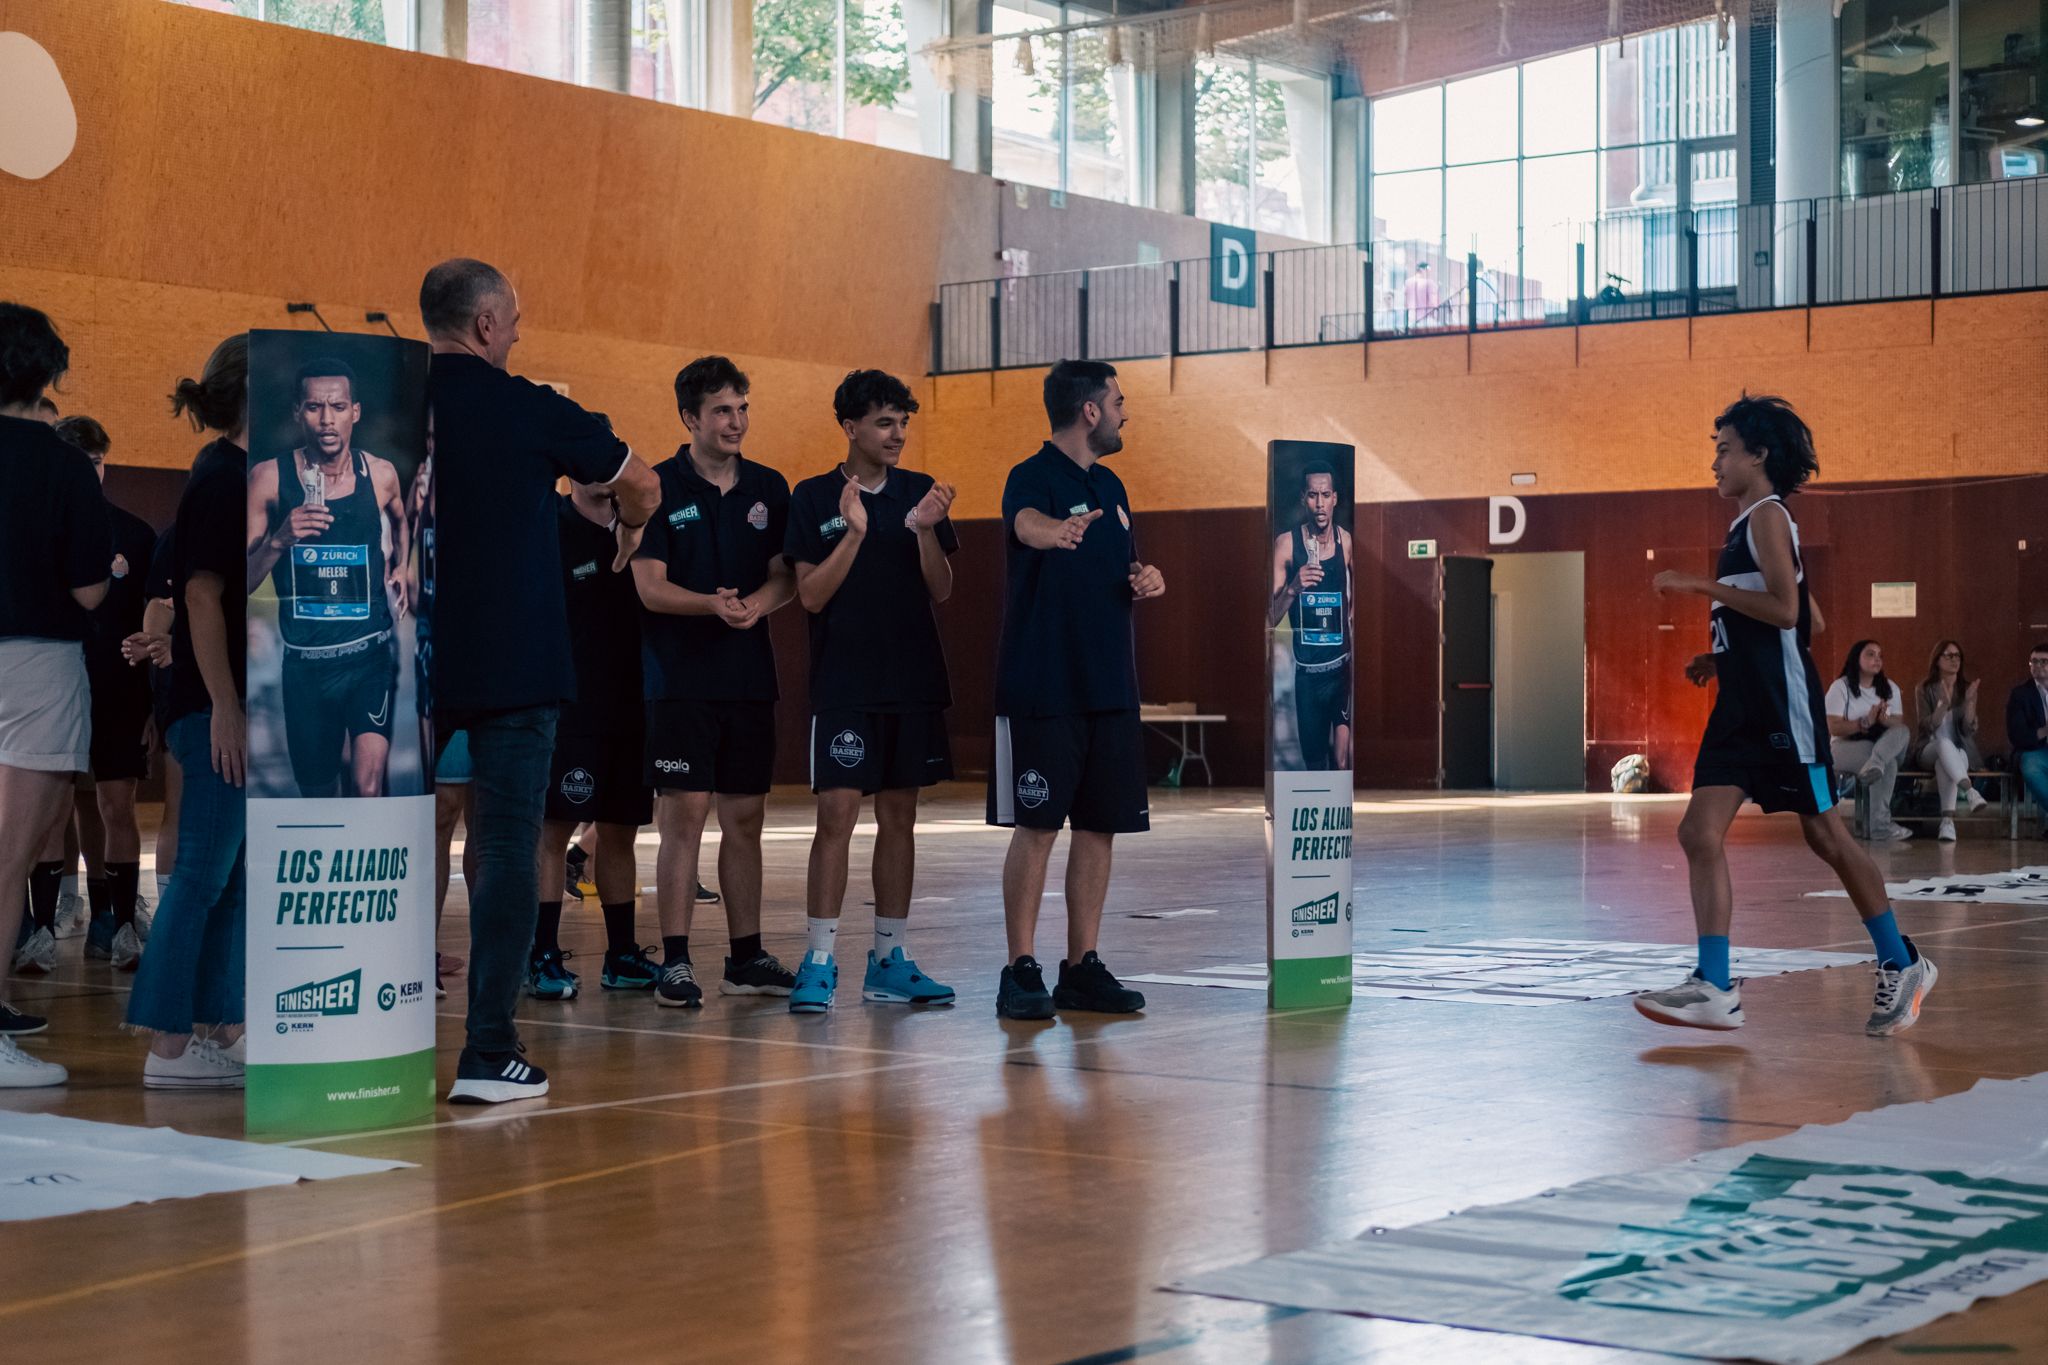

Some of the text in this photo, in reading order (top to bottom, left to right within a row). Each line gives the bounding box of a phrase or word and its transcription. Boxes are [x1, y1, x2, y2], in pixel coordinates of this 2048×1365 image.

[1222, 237, 1248, 289] D
[1489, 496, 1526, 545] D
[318, 566, 348, 578] MELESE
[330, 580, 337, 595] 8
[1322, 616, 1327, 628] 8
[1710, 617, 1729, 654] 21
[832, 747, 863, 757] BASKET
[655, 758, 689, 773] egala
[1018, 787, 1047, 798] BASKET
[1292, 807, 1319, 831] LOS
[276, 846, 408, 884] LOS ALIADOS
[276, 888, 398, 925] PERFECTOS
[1293, 899, 1336, 921] FINISHER
[278, 978, 354, 1011] FINISHER
[400, 981, 422, 996] KERN
[327, 1085, 400, 1101] www.finisher.es
